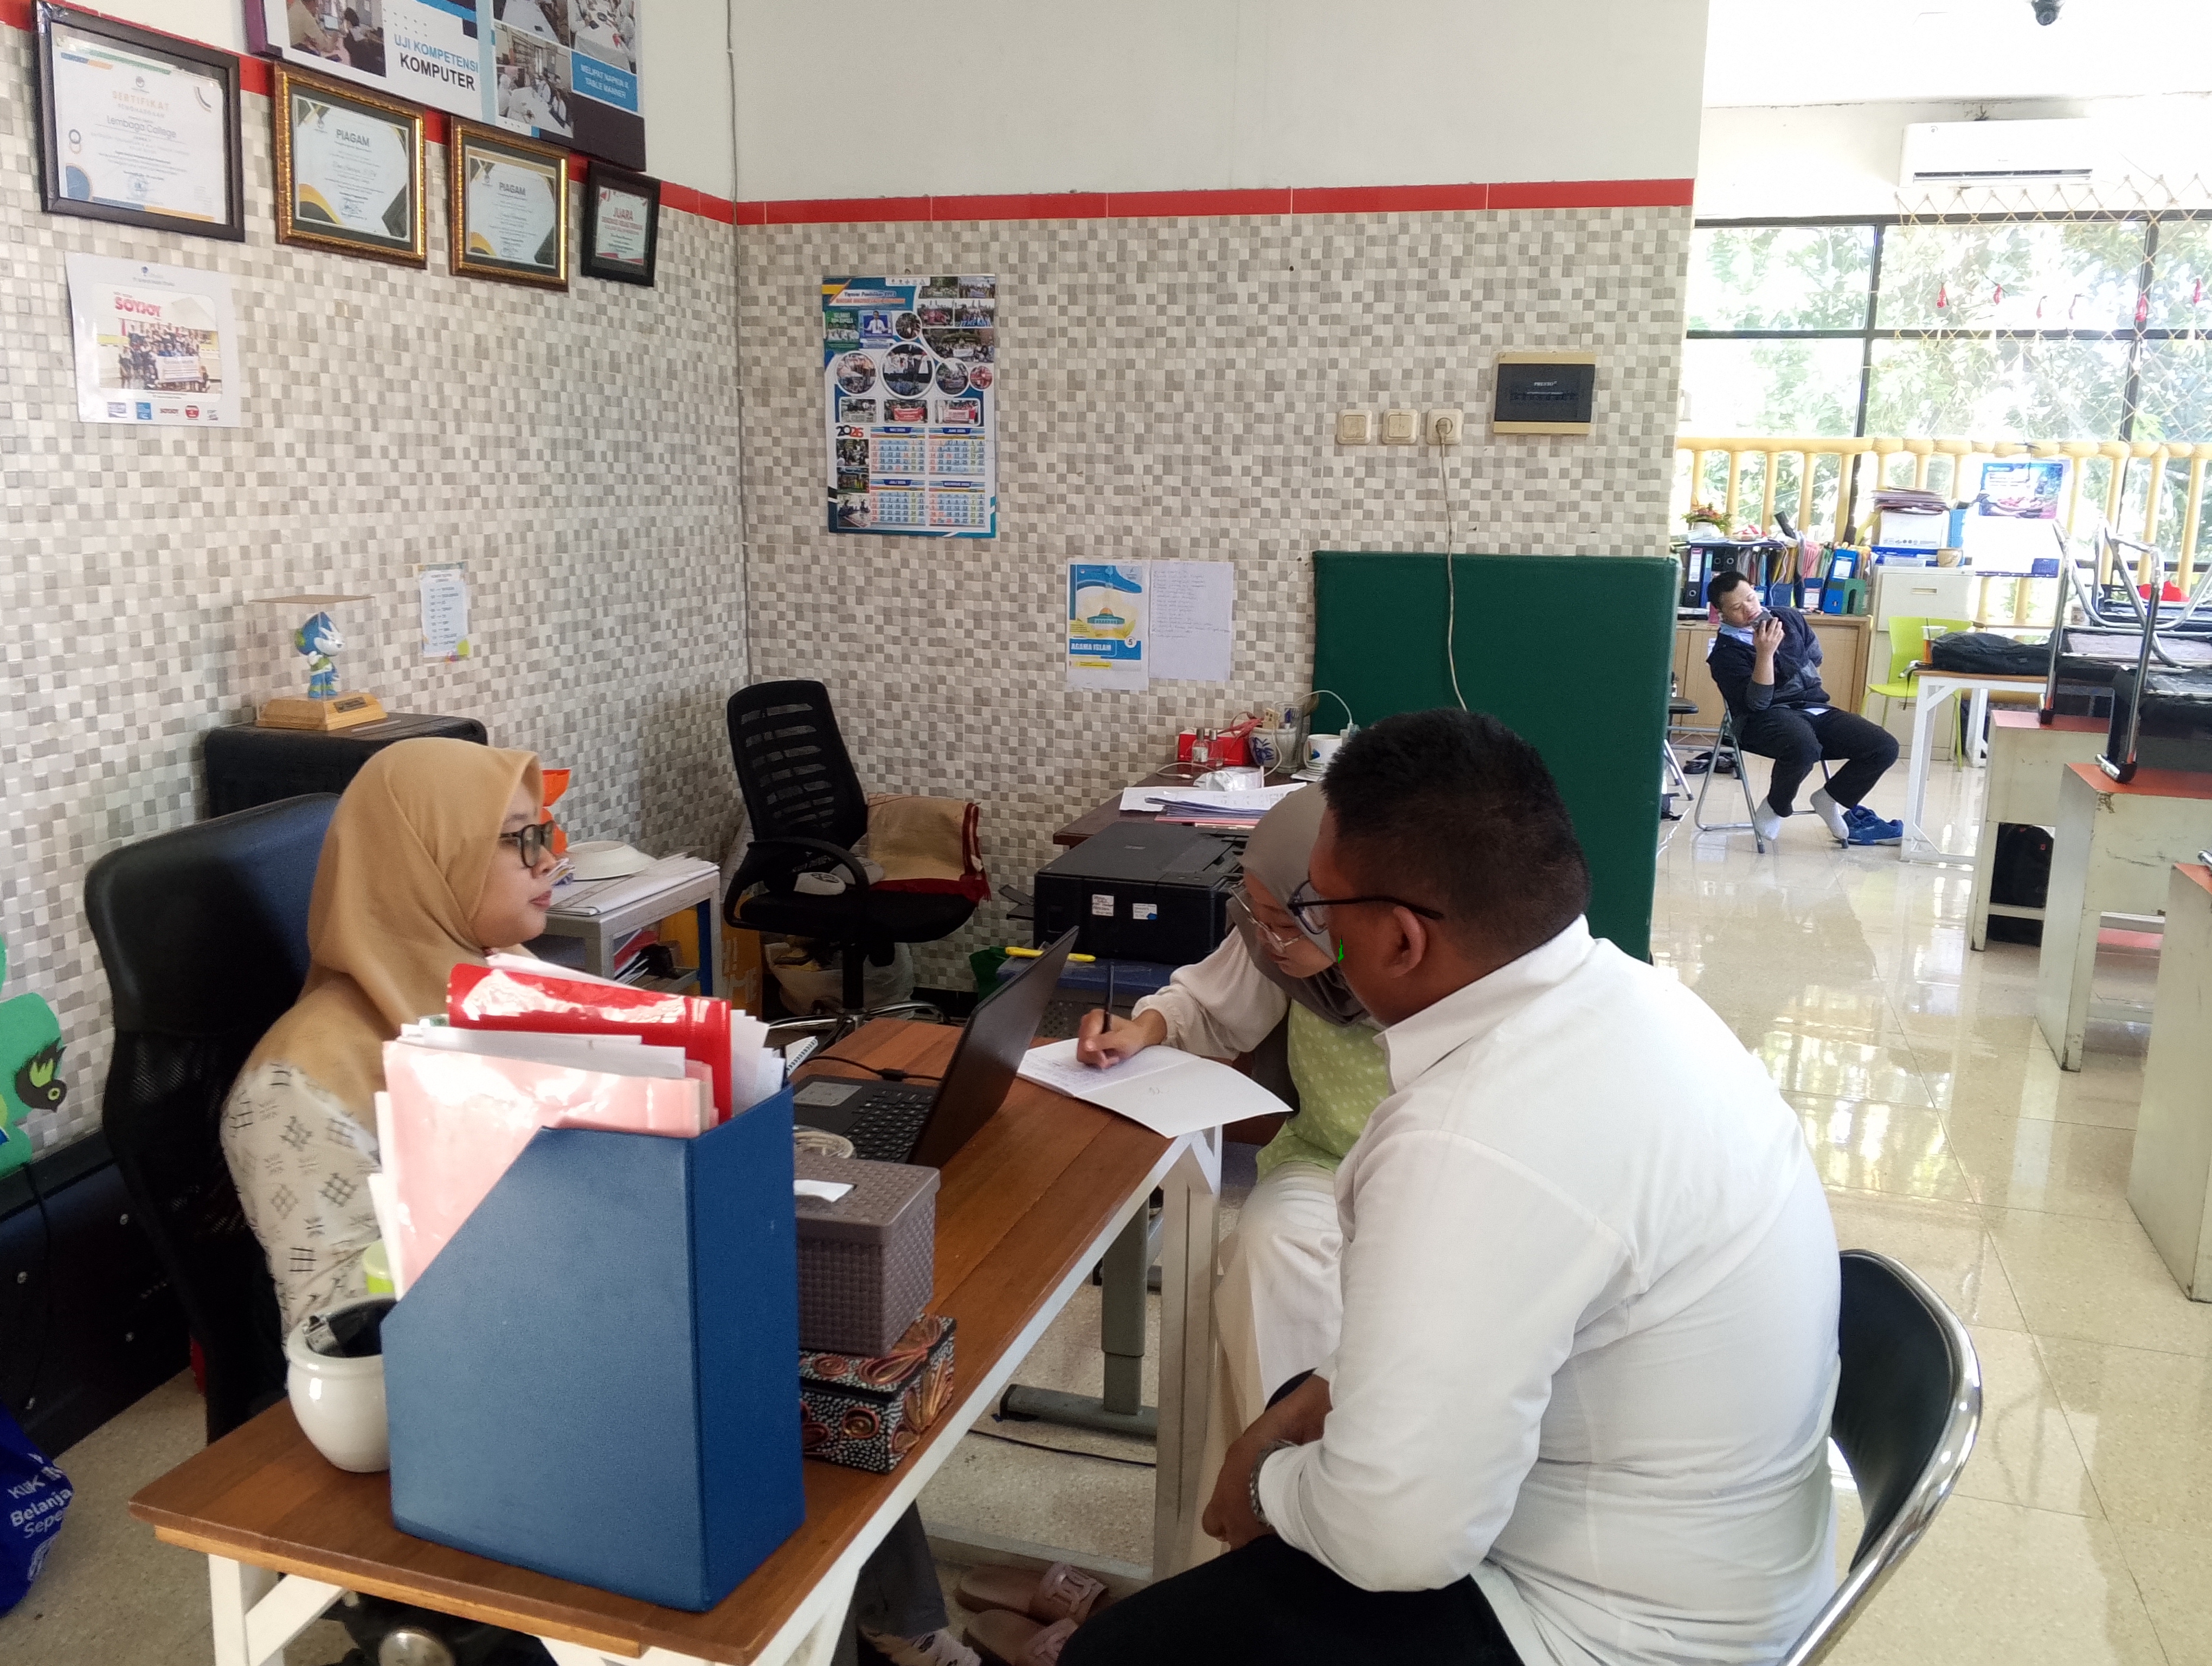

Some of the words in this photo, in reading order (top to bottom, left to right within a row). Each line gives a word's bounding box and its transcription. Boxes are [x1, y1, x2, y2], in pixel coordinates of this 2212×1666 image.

[394, 34, 411, 49] UJI
[414, 40, 478, 73] KOMPETENSI
[400, 52, 475, 91] KOMPUTER
[112, 91, 170, 110] SERTIFIKAT
[106, 115, 145, 132] Lembaga
[336, 129, 370, 147] PIAGAM
[499, 182, 526, 196] PIAGAM
[114, 296, 161, 317] SOYJOY
[835, 424, 864, 438] 2026
[10, 1488, 73, 1527] Belanja
